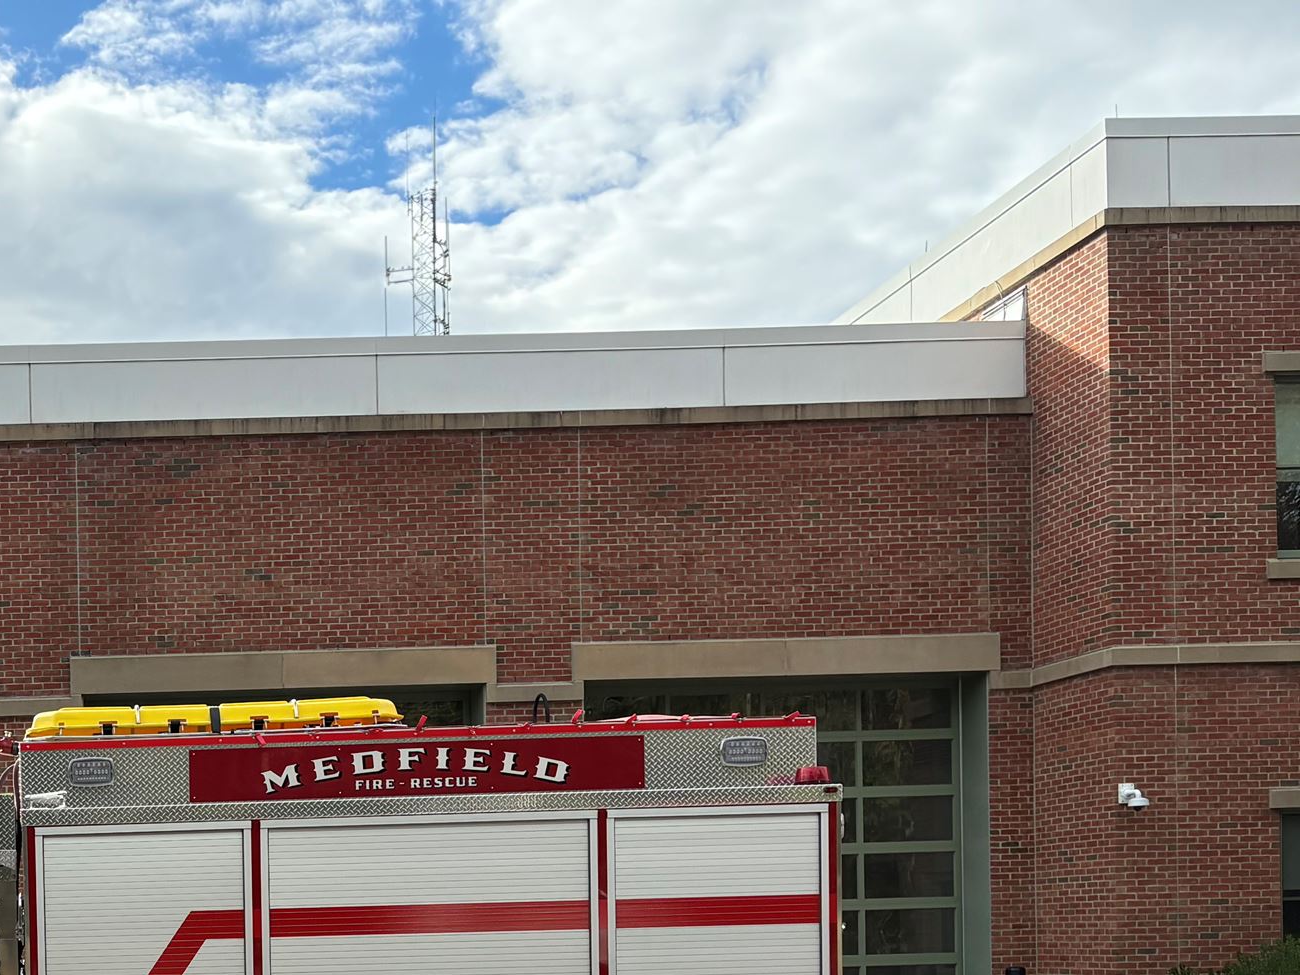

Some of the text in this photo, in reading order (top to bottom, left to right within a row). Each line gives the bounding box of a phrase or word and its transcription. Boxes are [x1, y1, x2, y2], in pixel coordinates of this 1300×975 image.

[261, 747, 570, 794] MEDFIELD
[355, 779, 395, 791] FIRE
[410, 776, 478, 789] RESCUE
